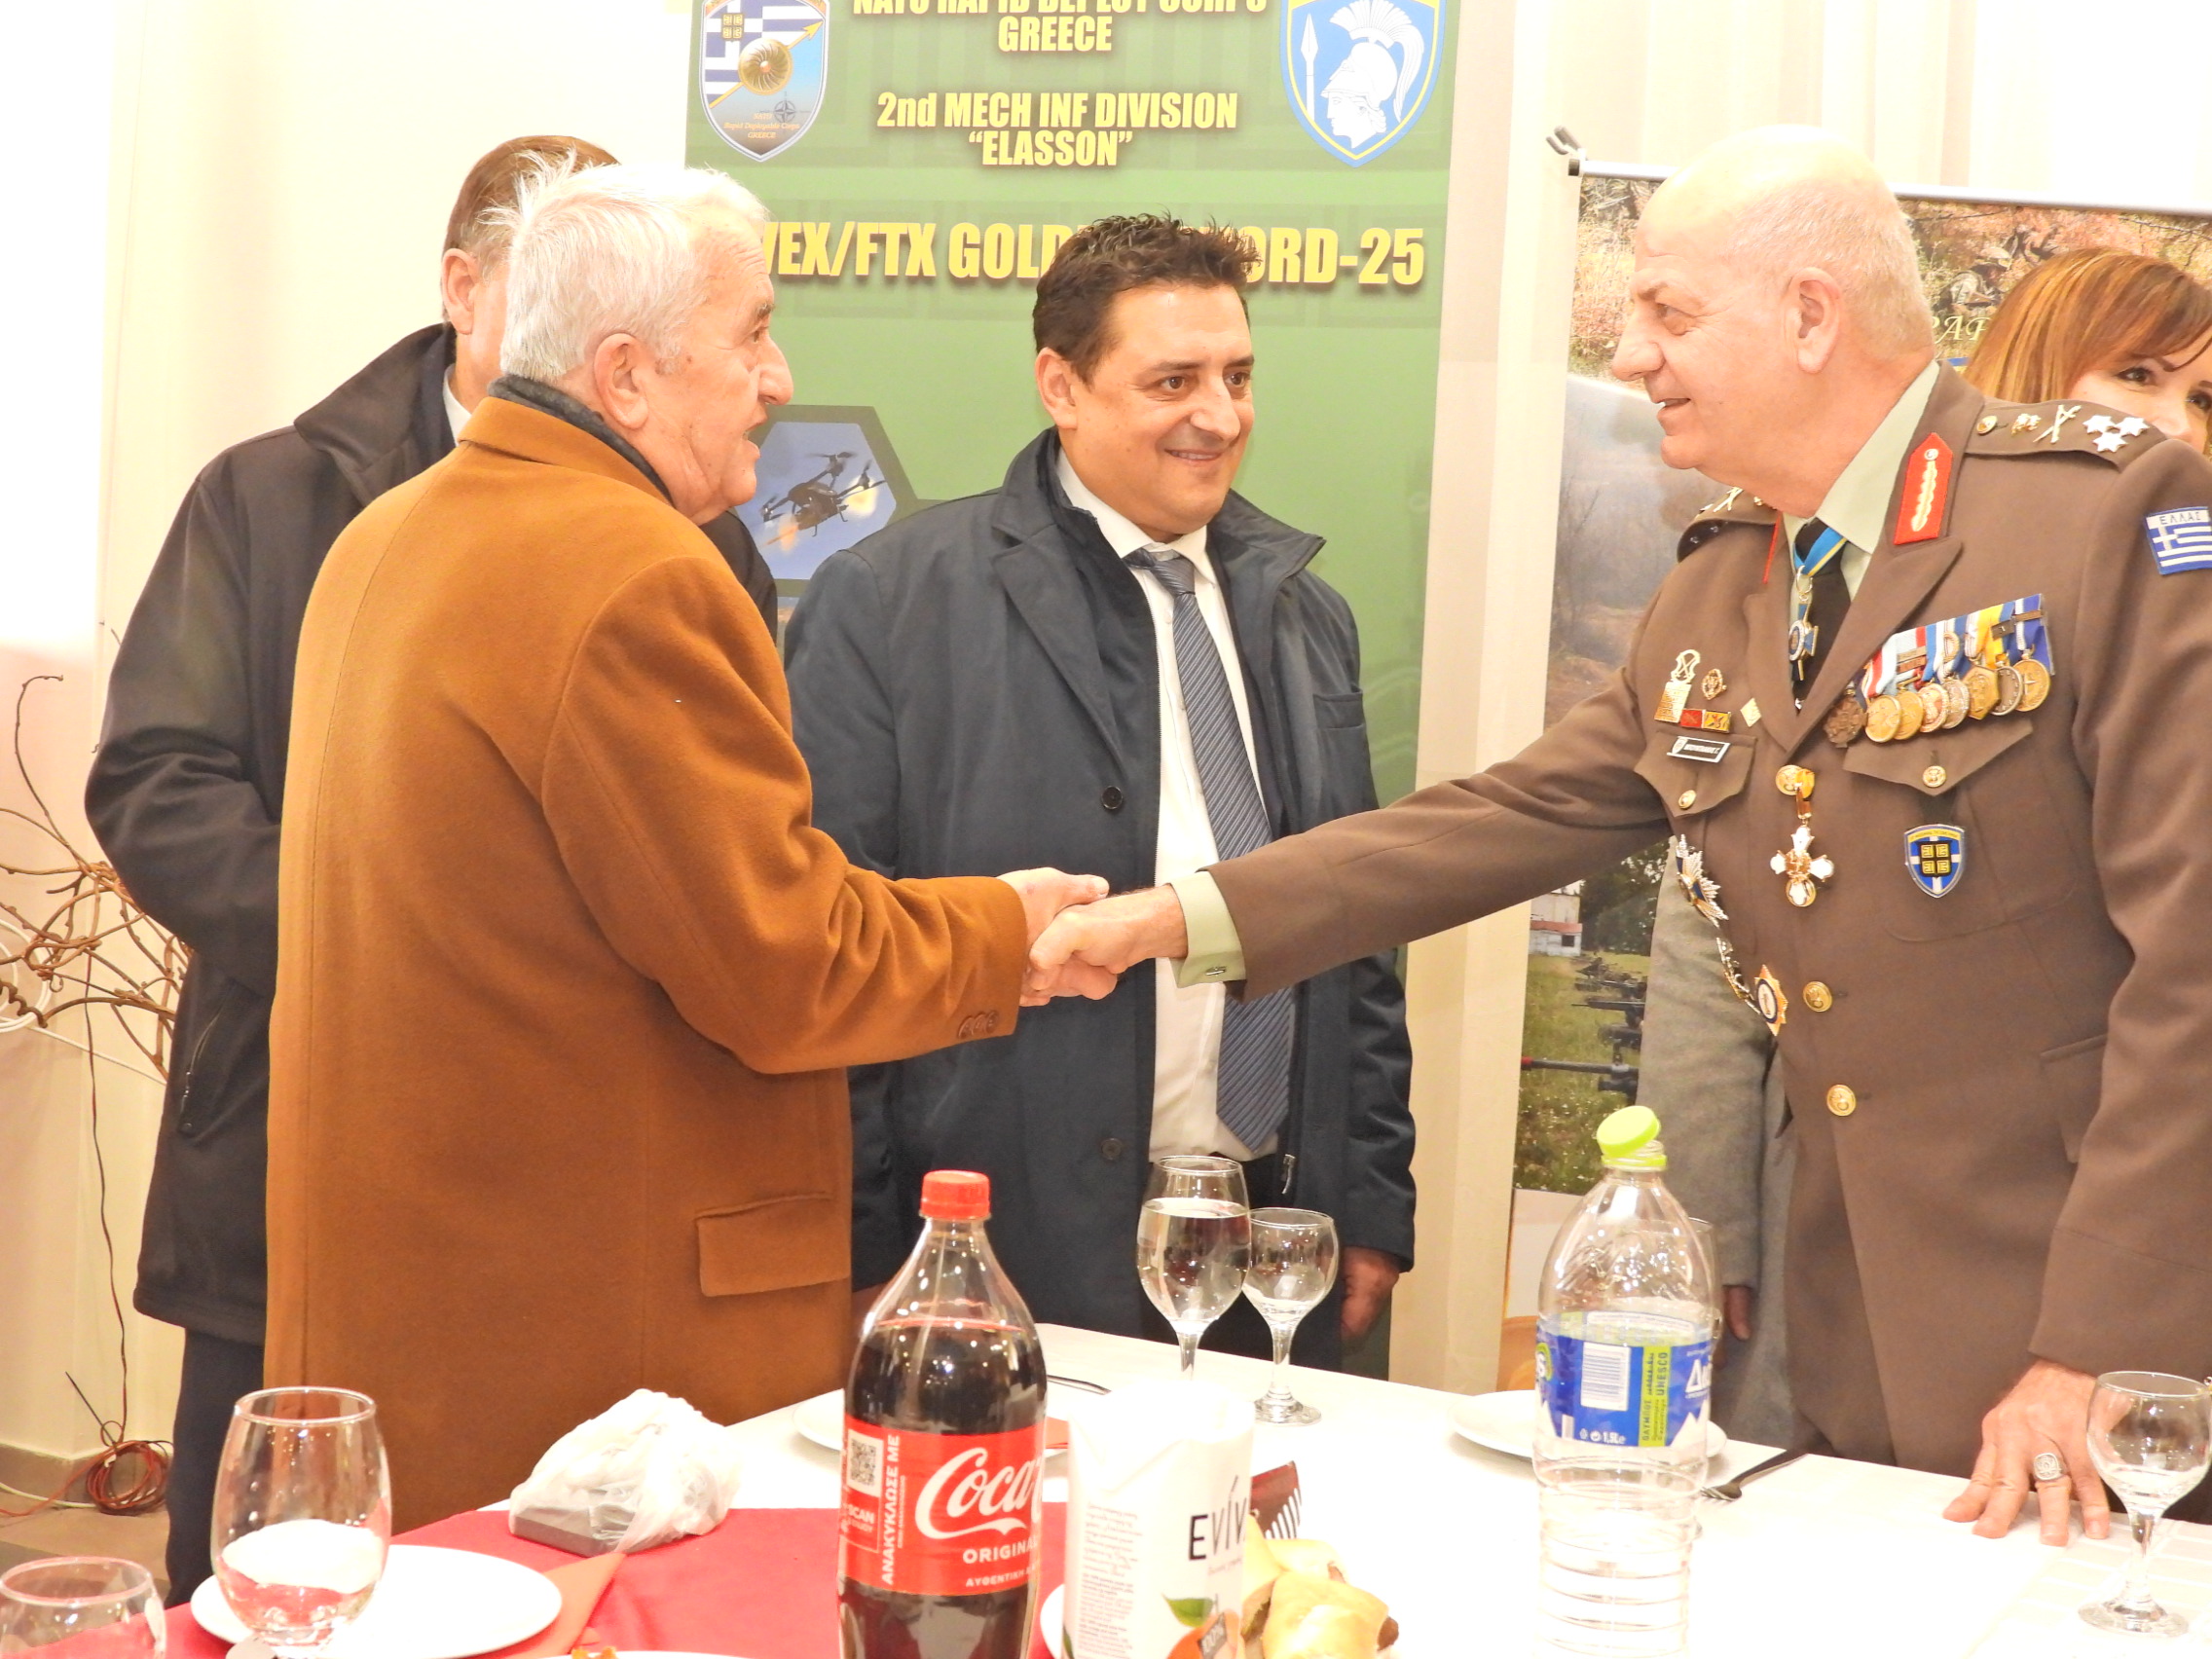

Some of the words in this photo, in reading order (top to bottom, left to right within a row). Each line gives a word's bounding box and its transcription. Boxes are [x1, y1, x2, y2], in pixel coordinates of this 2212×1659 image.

[998, 16, 1112, 52] GREECE
[876, 92, 937, 128] 2nd
[943, 92, 1032, 128] MECH
[1039, 92, 1088, 128] INF
[1095, 92, 1237, 129] DIVISION
[948, 222, 1092, 278] GOLD
[1236, 226, 1424, 284] ORD-25
[1655, 1351, 1669, 1397] UNESCO
[887, 1434, 901, 1462] ΜΕ
[881, 1465, 900, 1586] ΑΝΑΚΥΚΛΩΣΕ
